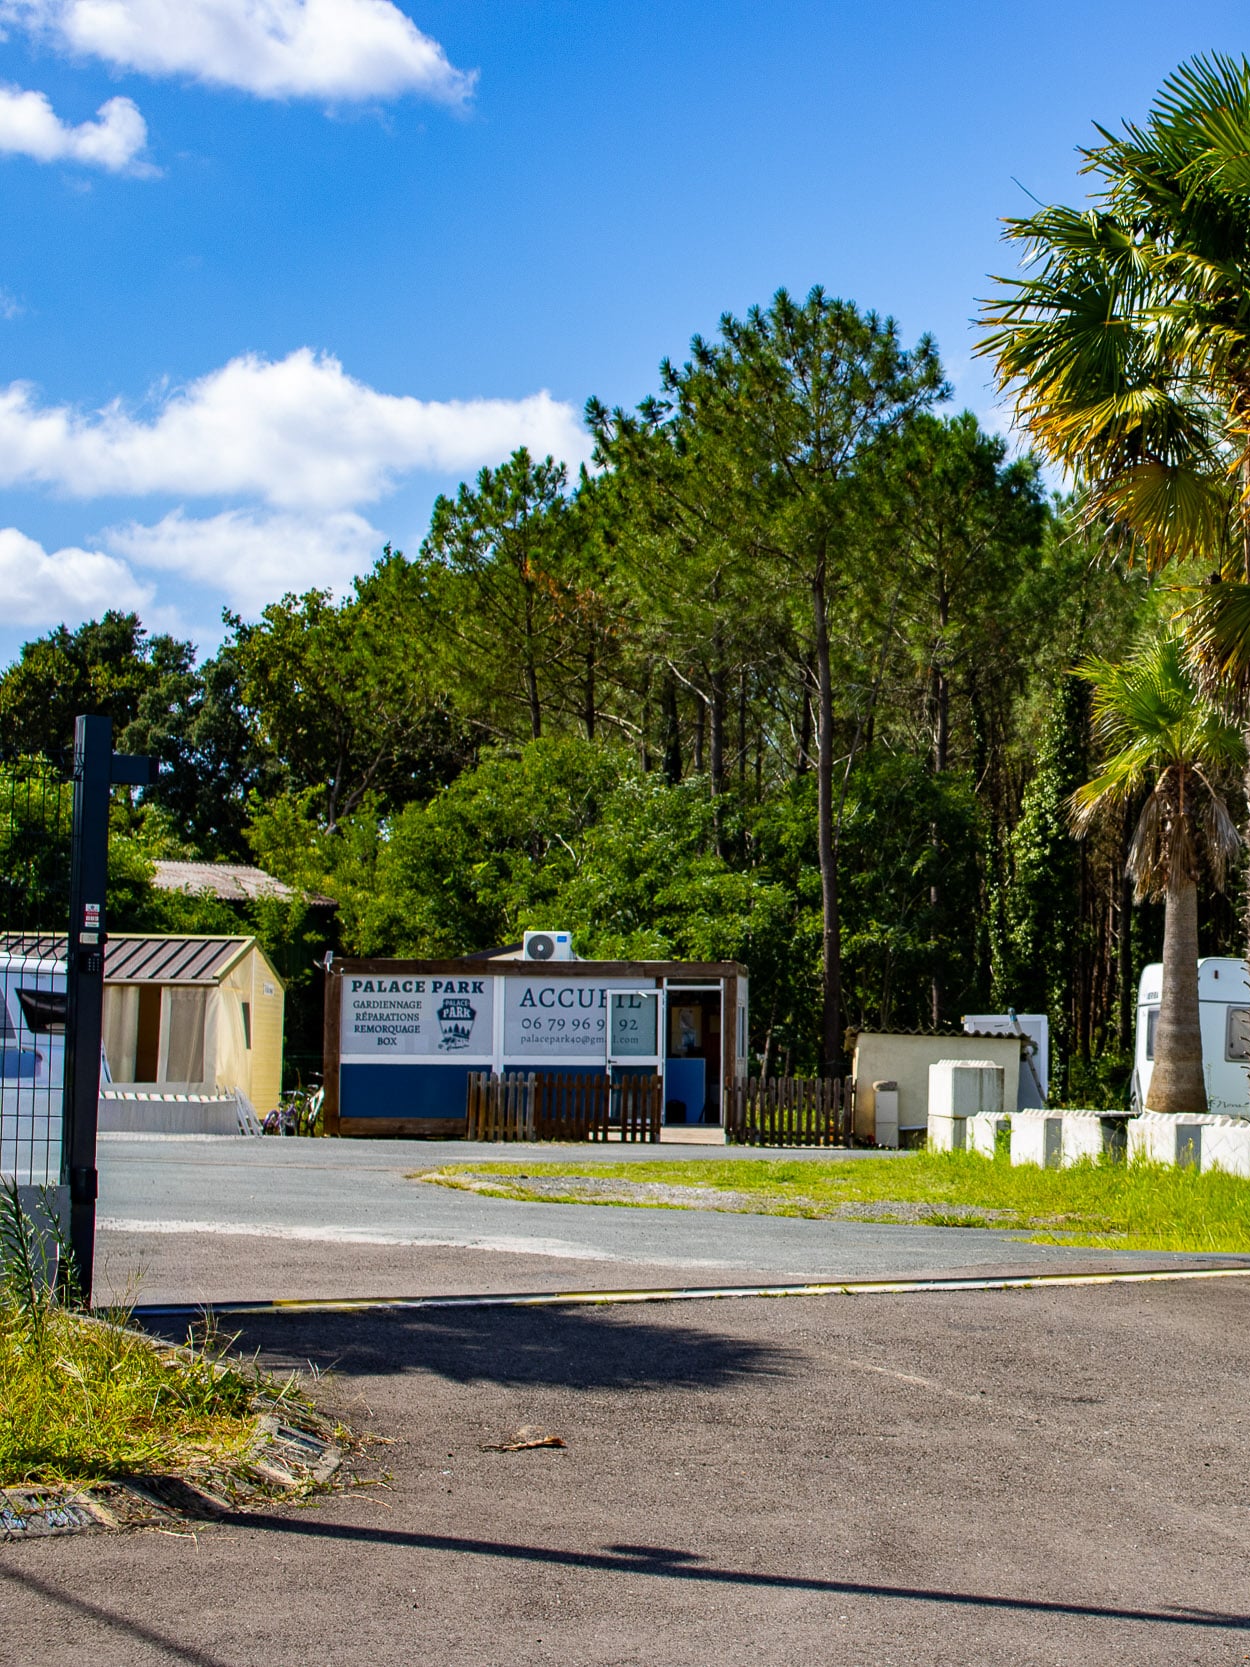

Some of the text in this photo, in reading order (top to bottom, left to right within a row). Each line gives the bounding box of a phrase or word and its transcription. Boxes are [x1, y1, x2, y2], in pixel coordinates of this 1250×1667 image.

[351, 980, 485, 994] PALACE PARK
[353, 1000, 422, 1009] GARDIENNAGE
[355, 1011, 420, 1022] RÉPARATIONS
[443, 1006, 471, 1018] PARK
[354, 1025, 421, 1035] REMORQUAGE
[521, 1017, 638, 1032] 06 79 96 9 92
[377, 1037, 398, 1046] BOX
[520, 1033, 639, 1045] palacepark40@gml.com
